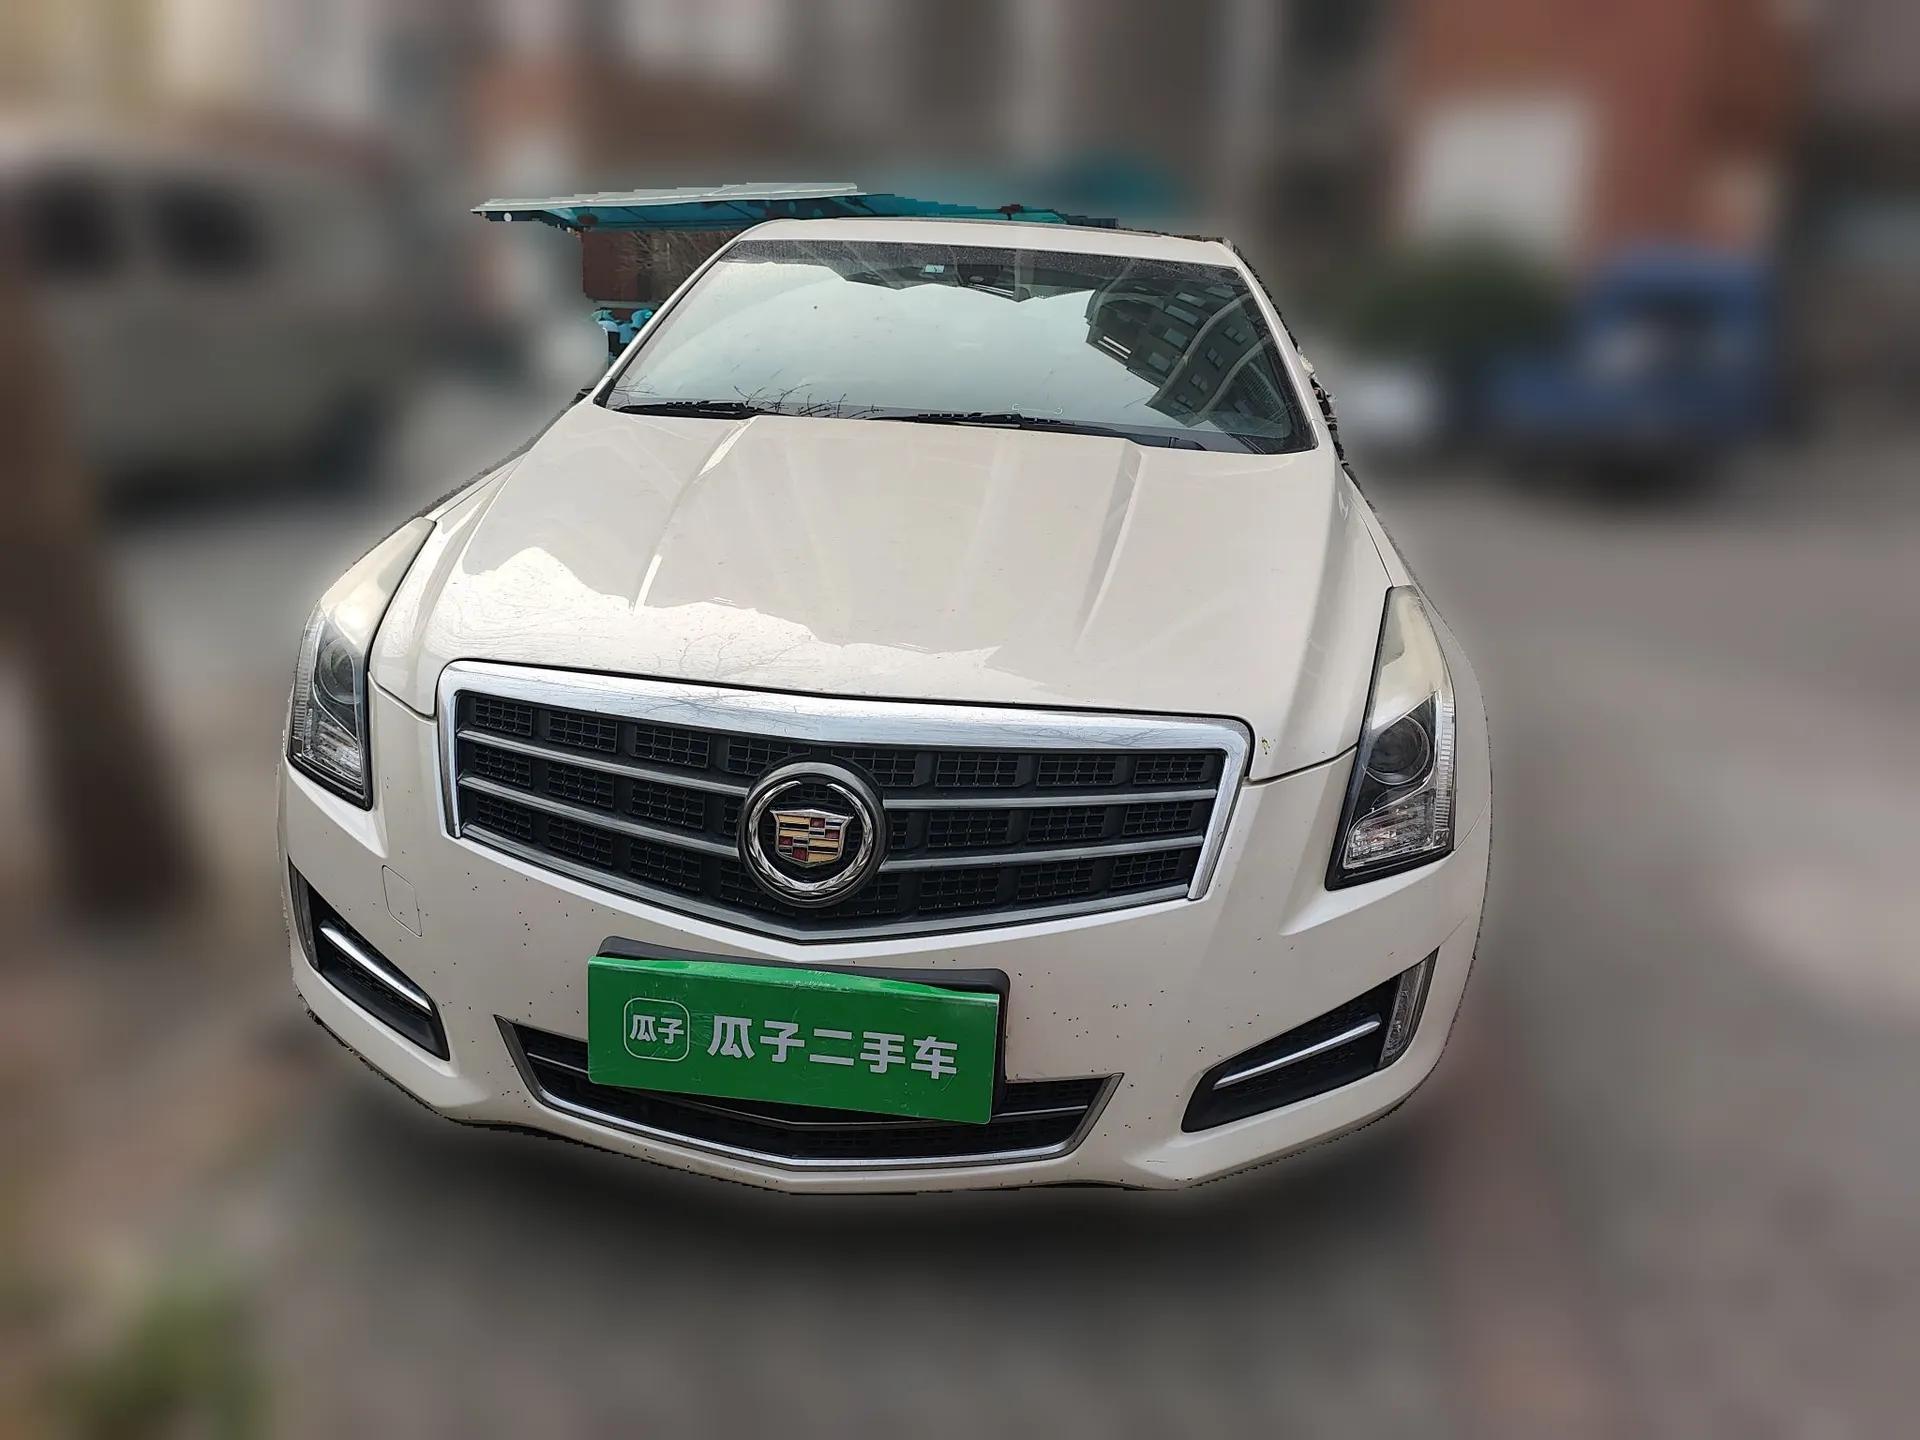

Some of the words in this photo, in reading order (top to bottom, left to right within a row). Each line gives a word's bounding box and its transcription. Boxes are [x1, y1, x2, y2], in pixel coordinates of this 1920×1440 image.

[629, 1014, 684, 1044] 瓜子
[707, 1014, 958, 1080] 瓜子二手车
